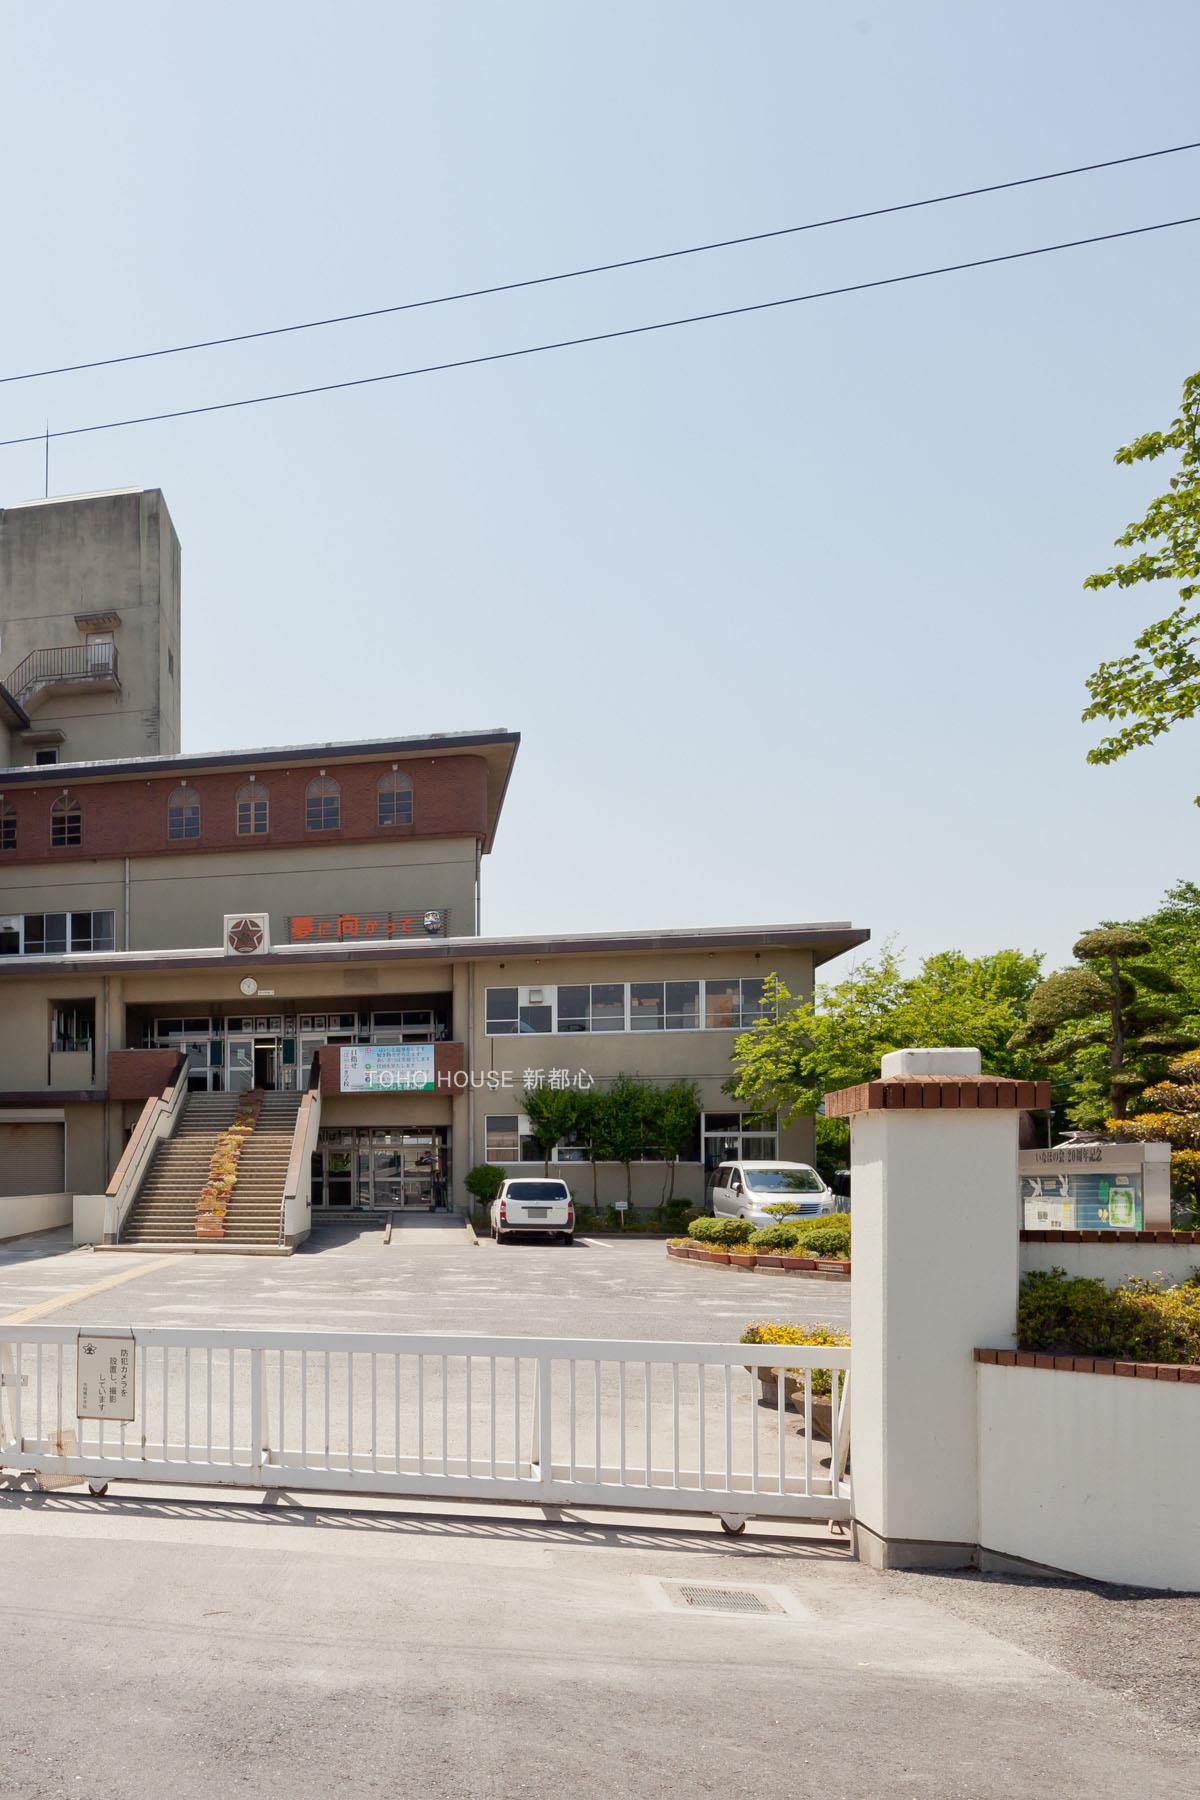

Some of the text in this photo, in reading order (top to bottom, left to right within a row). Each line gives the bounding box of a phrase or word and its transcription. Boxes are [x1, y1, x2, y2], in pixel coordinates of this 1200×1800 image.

[290, 915, 417, 940] 夢に向かって
[98, 1372, 106, 1411] しています
[120, 1349, 129, 1397] 防犯カメラを
